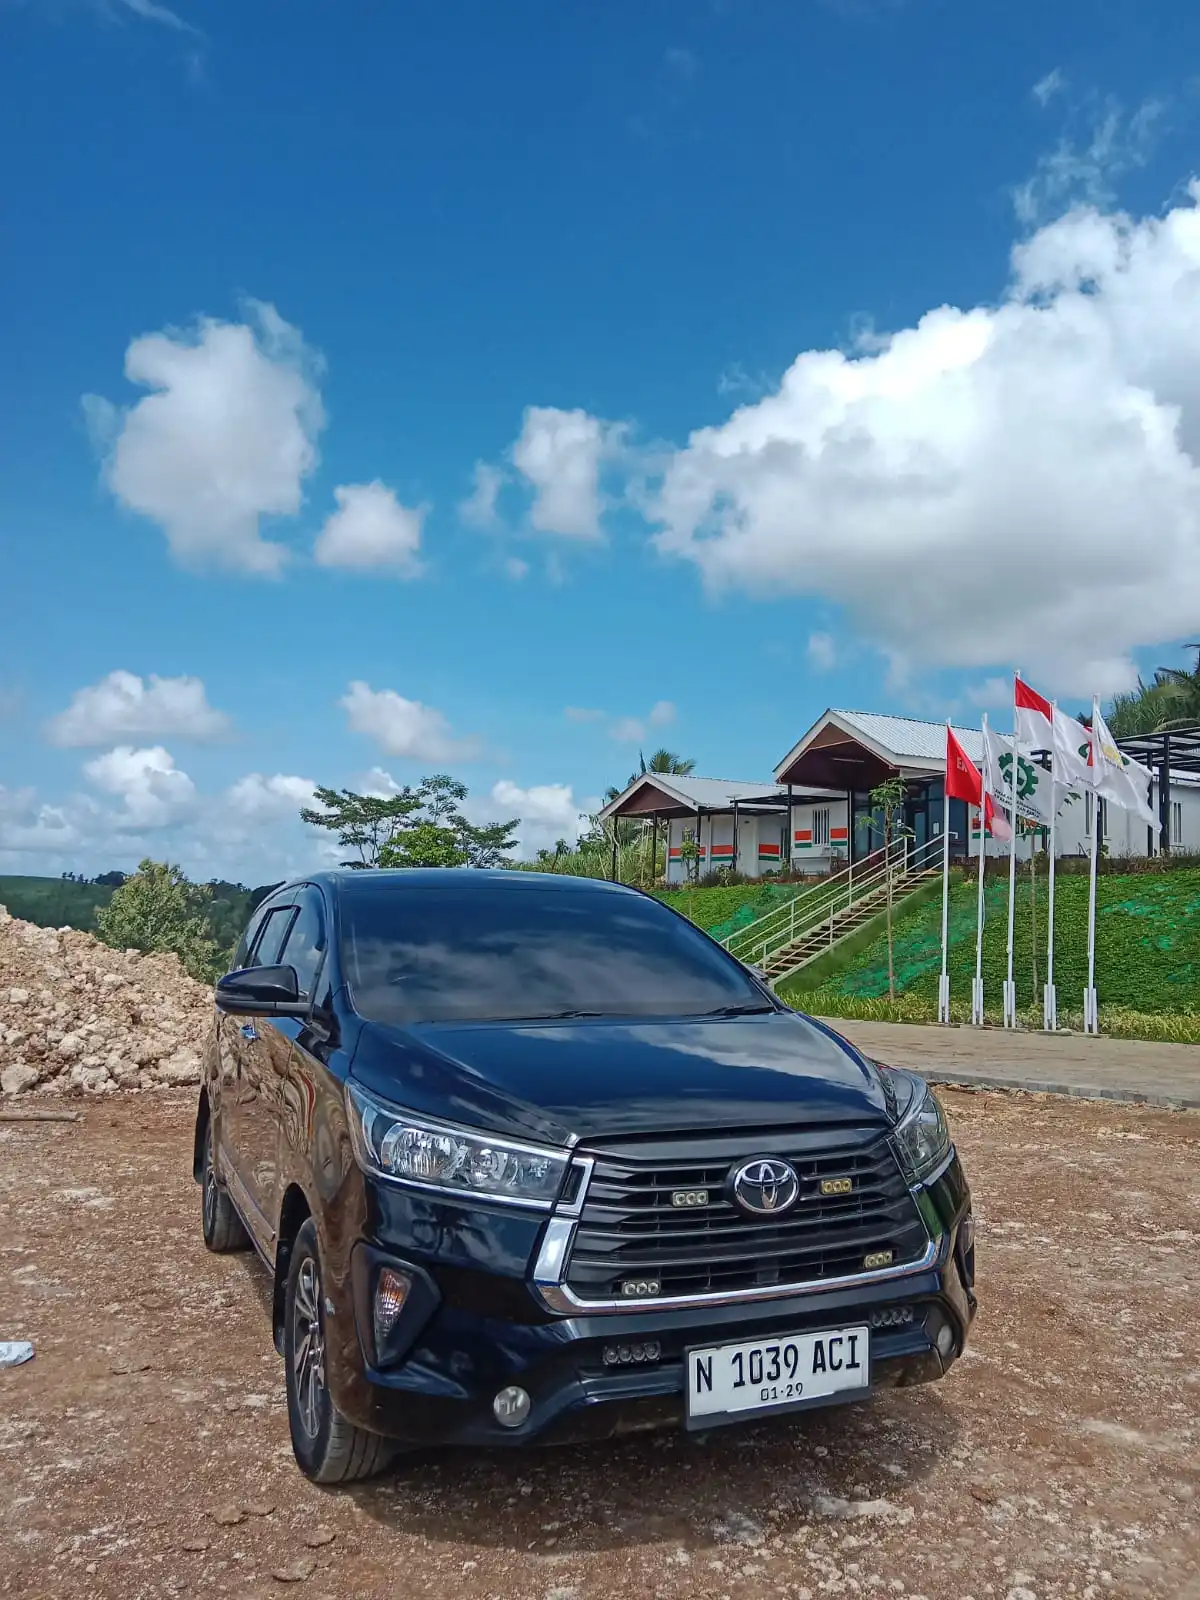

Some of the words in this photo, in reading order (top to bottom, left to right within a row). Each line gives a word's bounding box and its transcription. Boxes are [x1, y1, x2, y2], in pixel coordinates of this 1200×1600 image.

[696, 1356, 713, 1393] N
[731, 1343, 799, 1388] 1039
[812, 1335, 861, 1374] ACI
